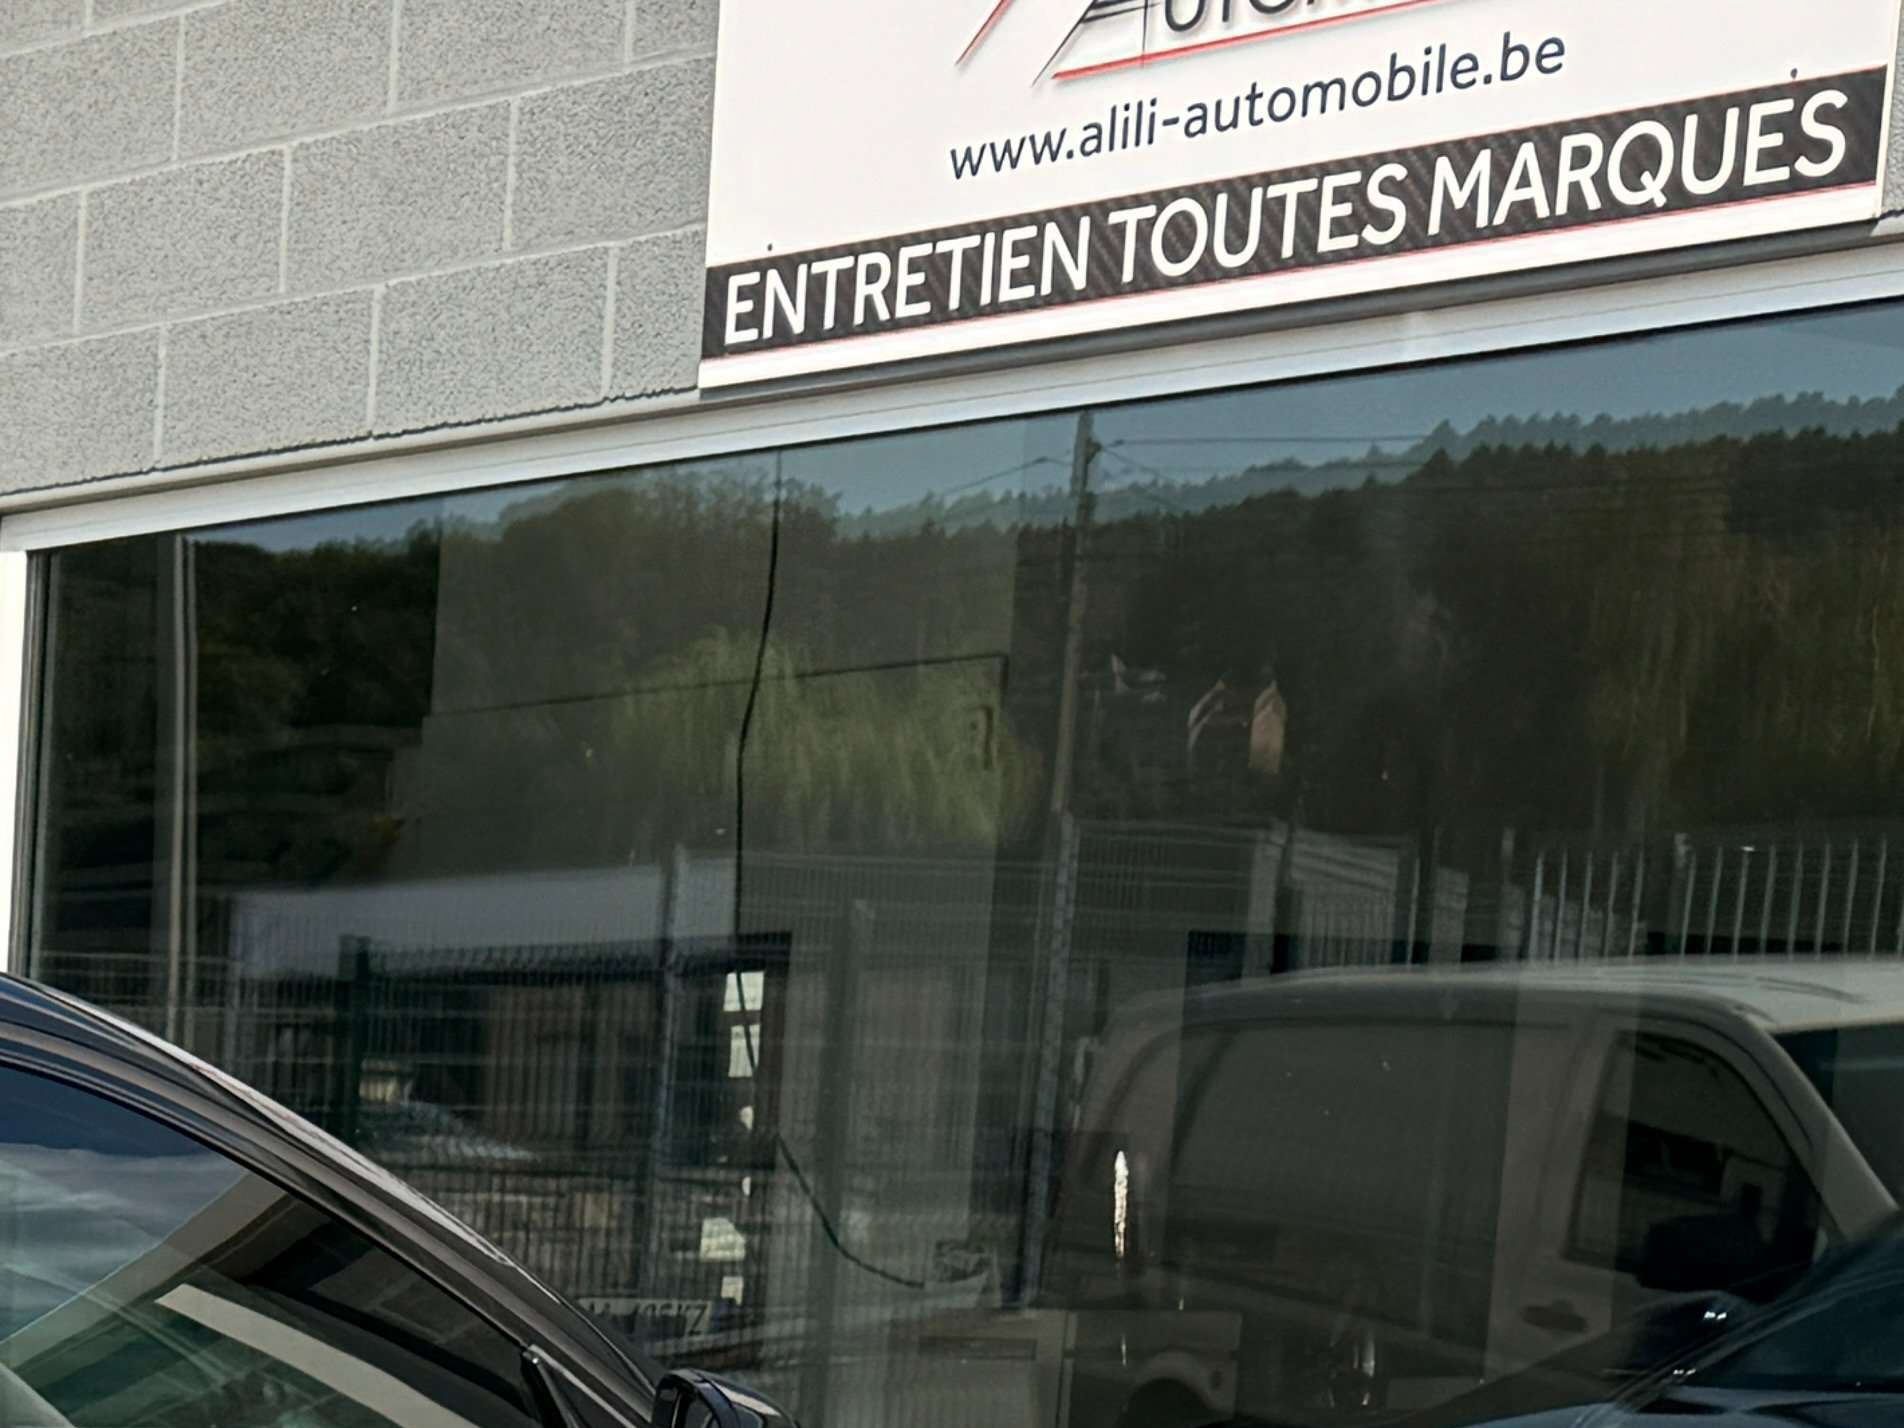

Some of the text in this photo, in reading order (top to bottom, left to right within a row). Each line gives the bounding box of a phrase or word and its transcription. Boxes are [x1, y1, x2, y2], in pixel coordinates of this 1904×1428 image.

[950, 31, 1566, 182] www.alili-automobile.be
[723, 89, 1849, 345] ENTRETIEN TOUTES MARQUES
